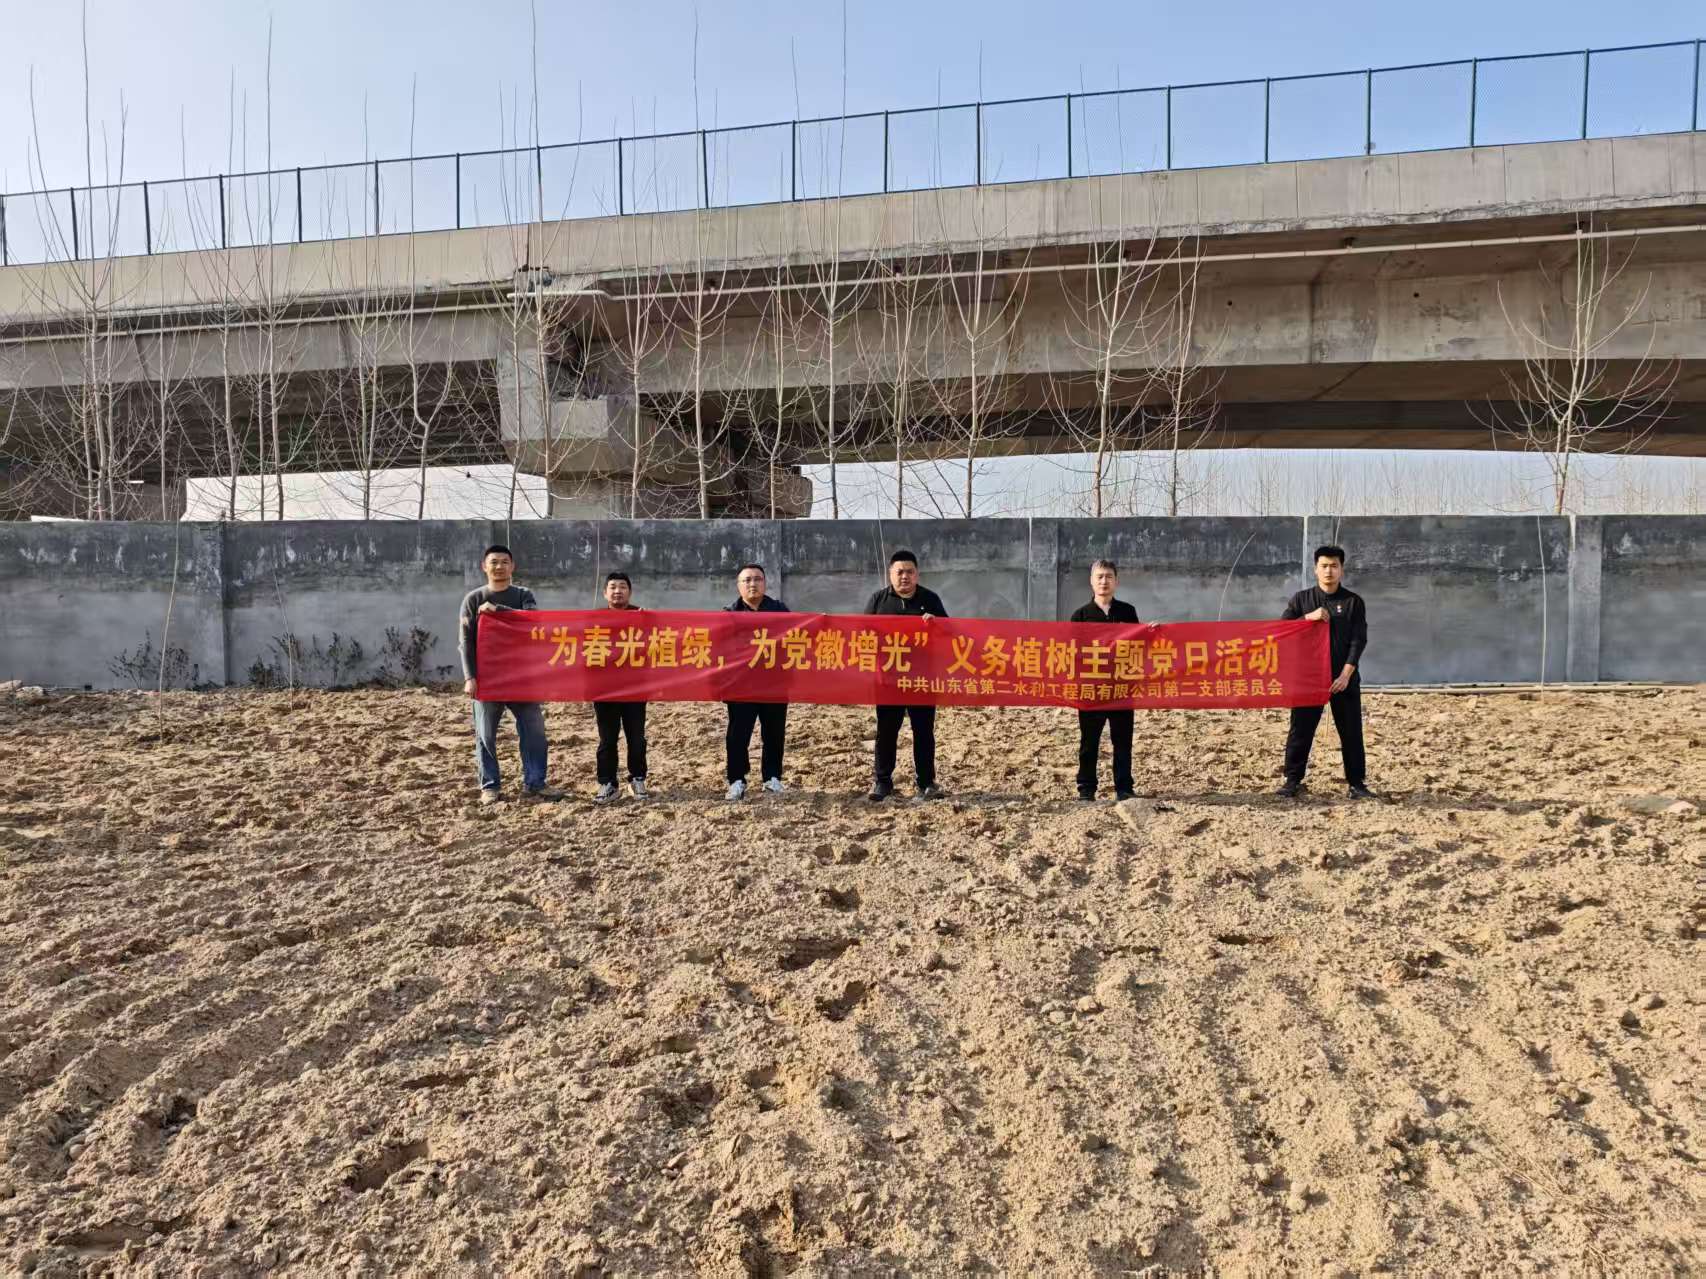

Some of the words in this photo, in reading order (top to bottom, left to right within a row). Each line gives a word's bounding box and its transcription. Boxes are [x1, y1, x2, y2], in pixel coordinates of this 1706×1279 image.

[896, 675, 1283, 702] 中共山东省第二水利工程局有限公司第二支部委员会
